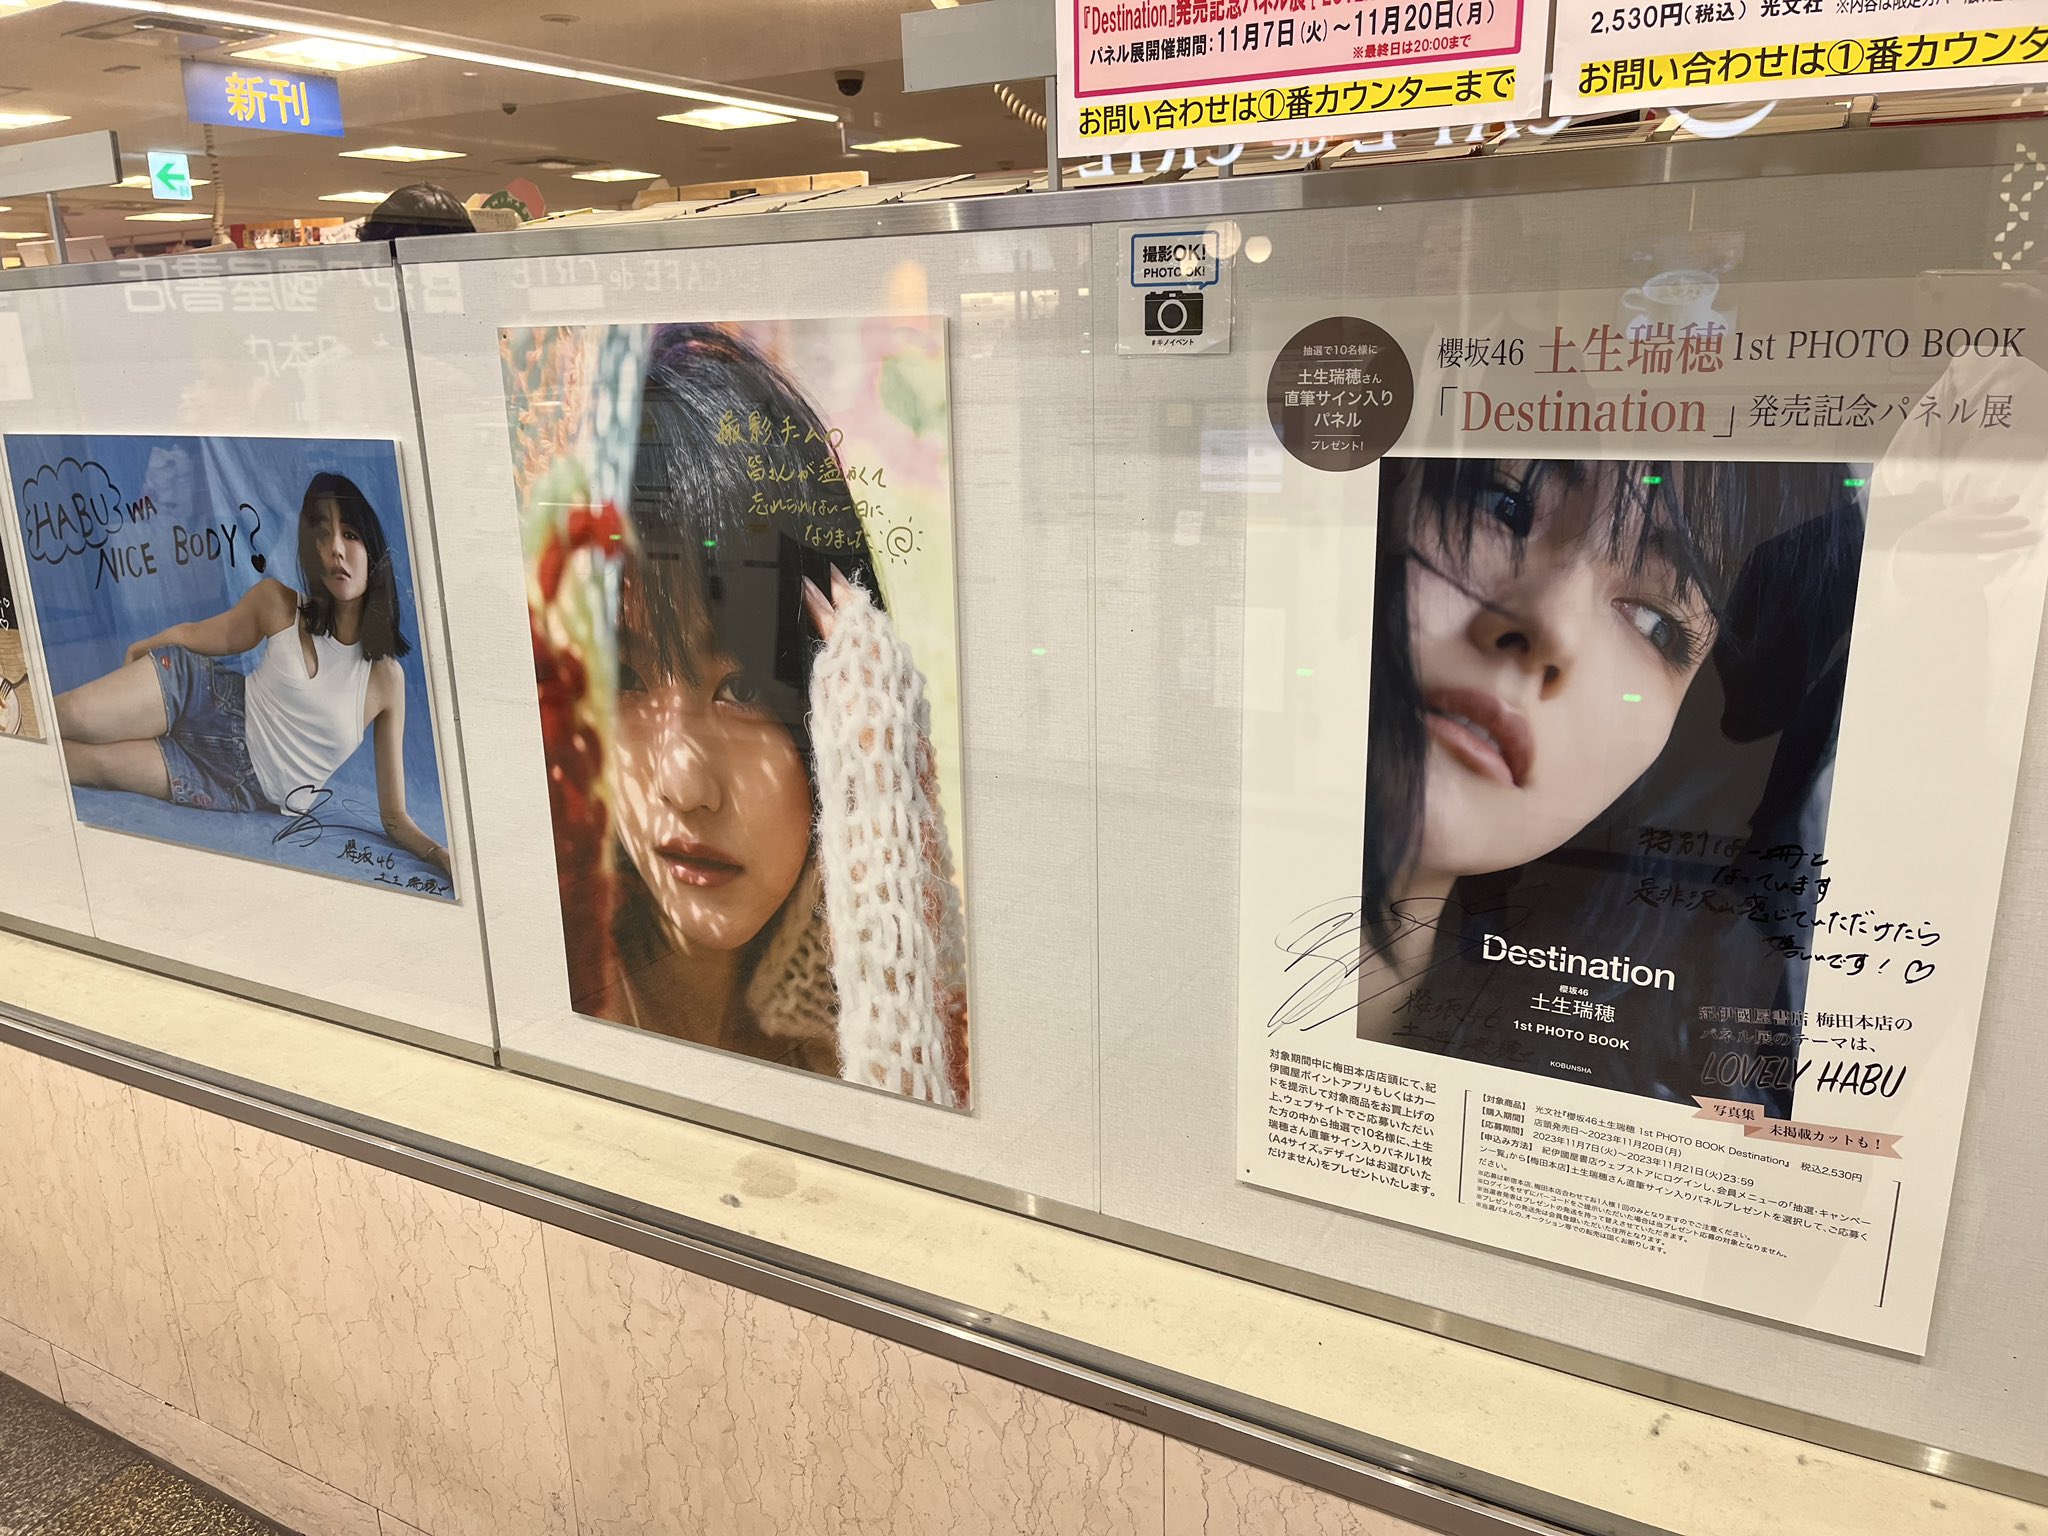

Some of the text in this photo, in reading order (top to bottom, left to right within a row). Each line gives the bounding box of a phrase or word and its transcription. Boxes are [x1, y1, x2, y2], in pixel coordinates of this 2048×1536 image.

[1761, 0, 1823, 17] 光文社
[1353, 34, 1472, 59] ※最終日は20:00まで
[225, 72, 311, 126] 新刊
[1079, 69, 1516, 135] お問い合わせは①番カウンターまで
[1143, 244, 1206, 263] 撮影OK!
[1303, 344, 1378, 356] 抽選で10名様に
[1437, 321, 2027, 375] 櫻坂46 土生瑞穂 1st PHOTO BOOK
[1297, 368, 1382, 386] 土生瑞穂さん
[1284, 389, 1394, 407] 直筆サイン入り
[1314, 412, 1362, 428] パネル
[1311, 440, 1364, 451] プレゼント!
[34, 493, 157, 549] HABU WA
[95, 542, 157, 589] NICE
[1482, 933, 1676, 991] Destination
[1558, 984, 1589, 997] 櫻坂46
[1530, 992, 1616, 1024] 土生瑞穂
[1698, 1005, 1913, 1032] 紀伊國屋書店 梅田本店の
[1513, 1020, 1631, 1051] 1st PHOTO BOOK
[1700, 1028, 1876, 1052] パネル展のテーマは、
[1269, 1048, 1437, 1094] 対象期間中に梅田本店店頭にて、紀
[1550, 1060, 1593, 1075] KOBUNSHA
[1701, 1051, 1908, 1098] LOVELY HABU
[1269, 1062, 1436, 1106] 伊國屋ポイントアプリもしくはカー
[1269, 1076, 1435, 1123] ドを提示して対象商品をお買上げの
[1713, 1103, 1756, 1121] 写真集
[1269, 1091, 1434, 1136] 上、ウェブサイトでご応募いただい
[1481, 1106, 1525, 1124] 【購入期間】
[1482, 1093, 1526, 1111] 【対象商品】
[1639, 1126, 1654, 1138] 1st
[1656, 1130, 1693, 1146] PHOTO
[1695, 1139, 1725, 1153] BOOK
[1268, 1105, 1433, 1153] た方の中から抽選で10名様に、土生
[1480, 1119, 1524, 1137] 【応募期間】
[1480, 1131, 1533, 1151] 【申込み方法】
[1769, 1123, 1881, 1150] 未掲載カットも!
[1268, 1118, 1433, 1167] 瑞穂さん直筆サイン入りパネル1枚
[1478, 1158, 1508, 1172] ださい。
